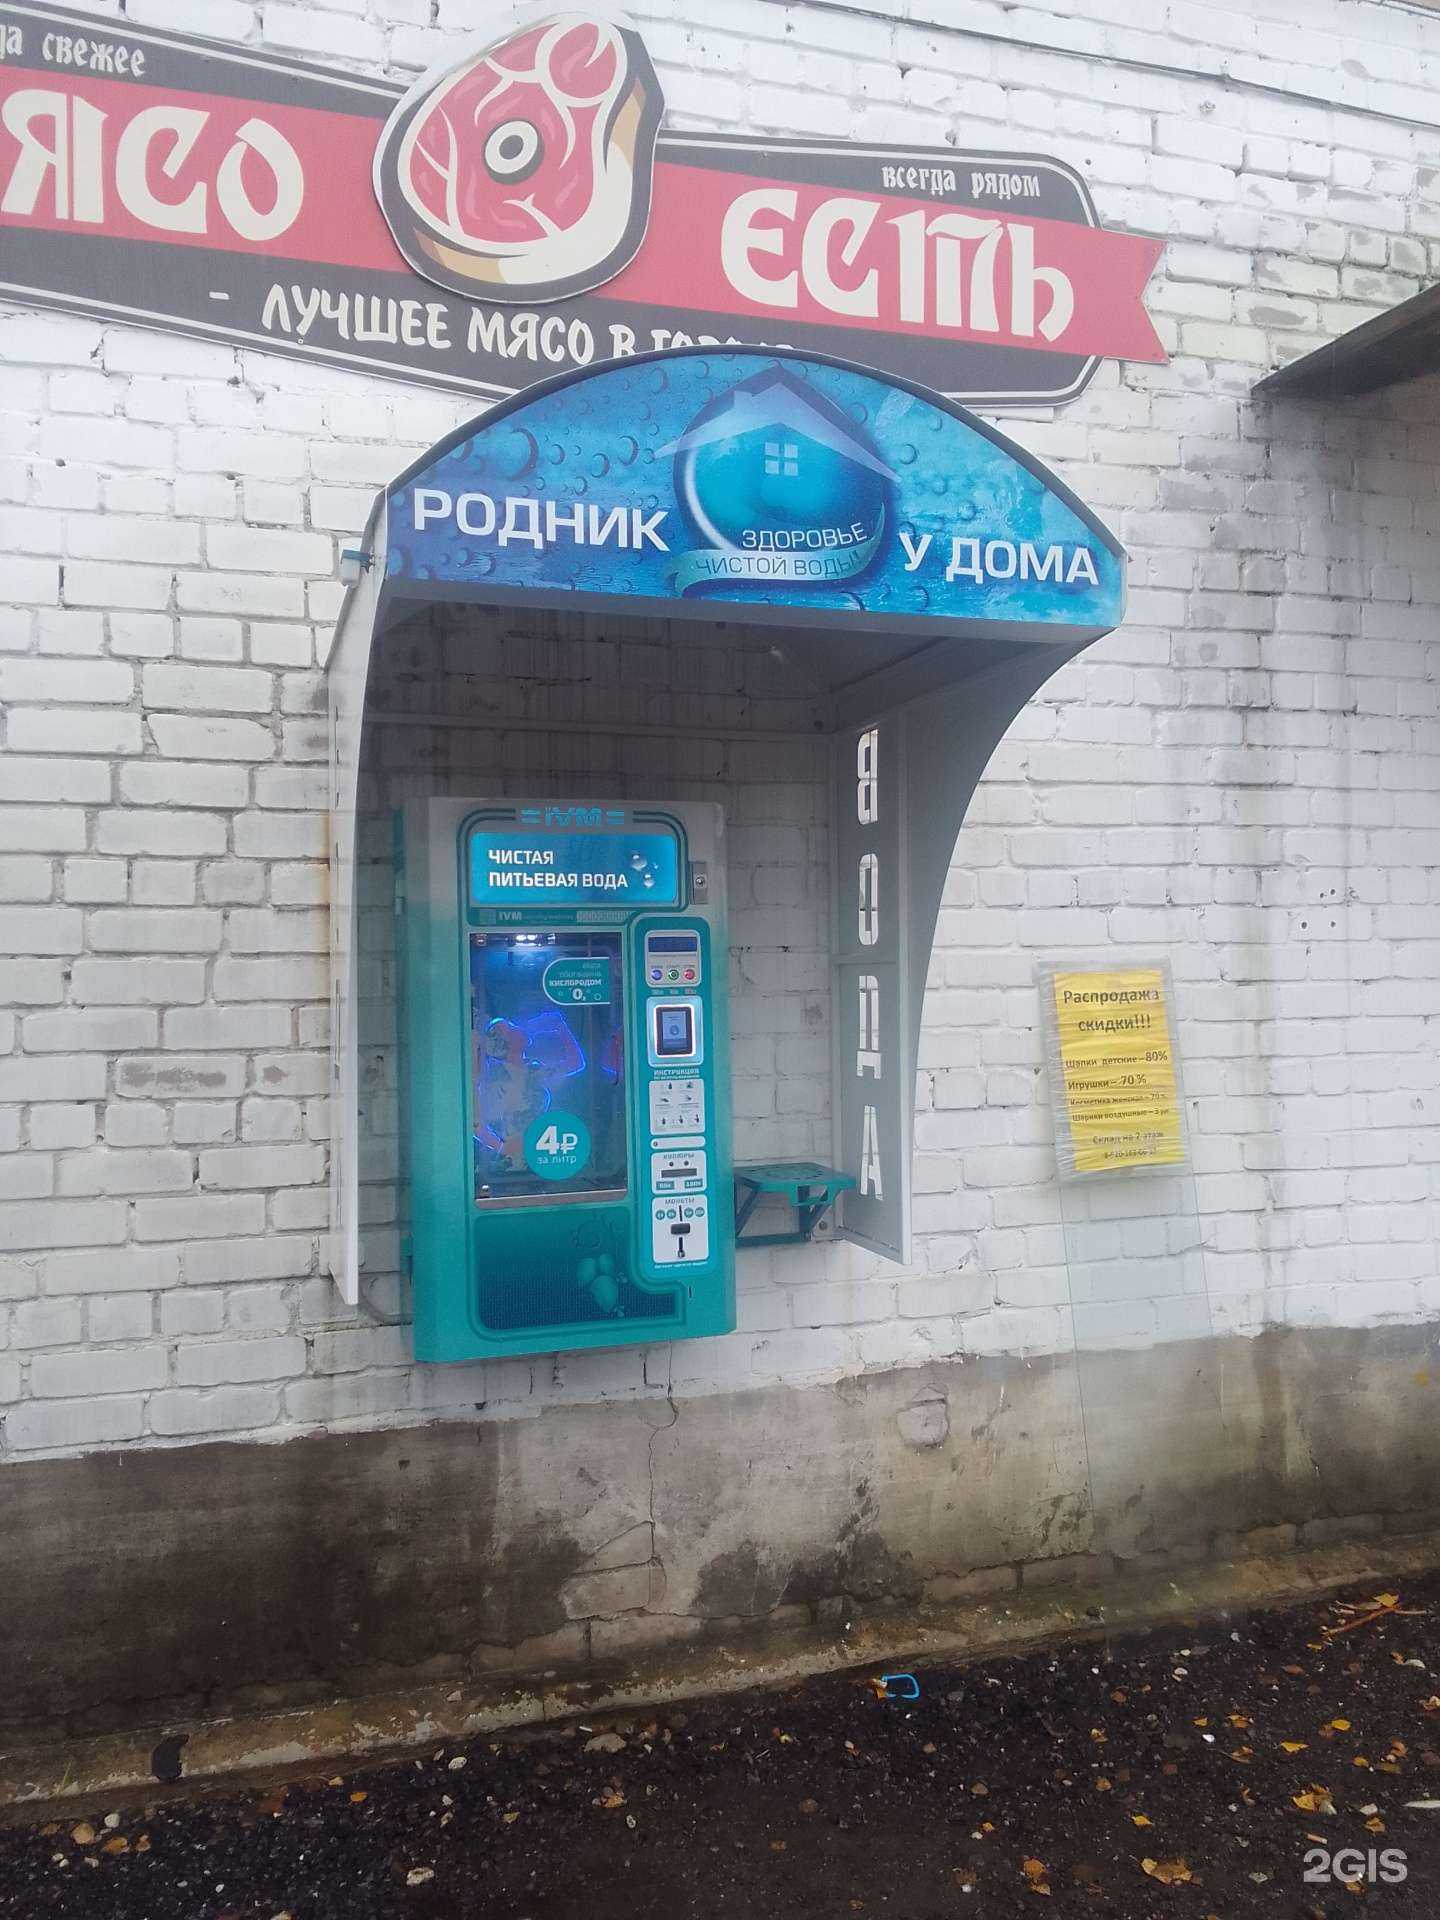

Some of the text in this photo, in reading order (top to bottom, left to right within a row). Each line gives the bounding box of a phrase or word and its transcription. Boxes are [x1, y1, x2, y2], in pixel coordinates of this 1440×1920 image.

[42, 32, 146, 78] свежее
[881, 165, 1041, 200] всегда рядом
[720, 188, 1075, 342] ЕСТЬ
[261, 284, 452, 349] ЛУЧШЕЕ
[467, 307, 594, 366] МЯСО
[413, 487, 1100, 586] РОДНИК У ДОМА
[741, 522, 868, 552] ЗДОРОВЬЕ
[696, 555, 787, 576] ЧИСТОЙ
[488, 849, 554, 865] ЧИСТАЯ
[488, 872, 628, 890] ПИТЬЕВАЯ ВОДА
[1063, 989, 1160, 1005] Распродажа
[1078, 1013, 1151, 1033] скидки!!!
[1068, 1079, 1109, 1091] Игрушки
